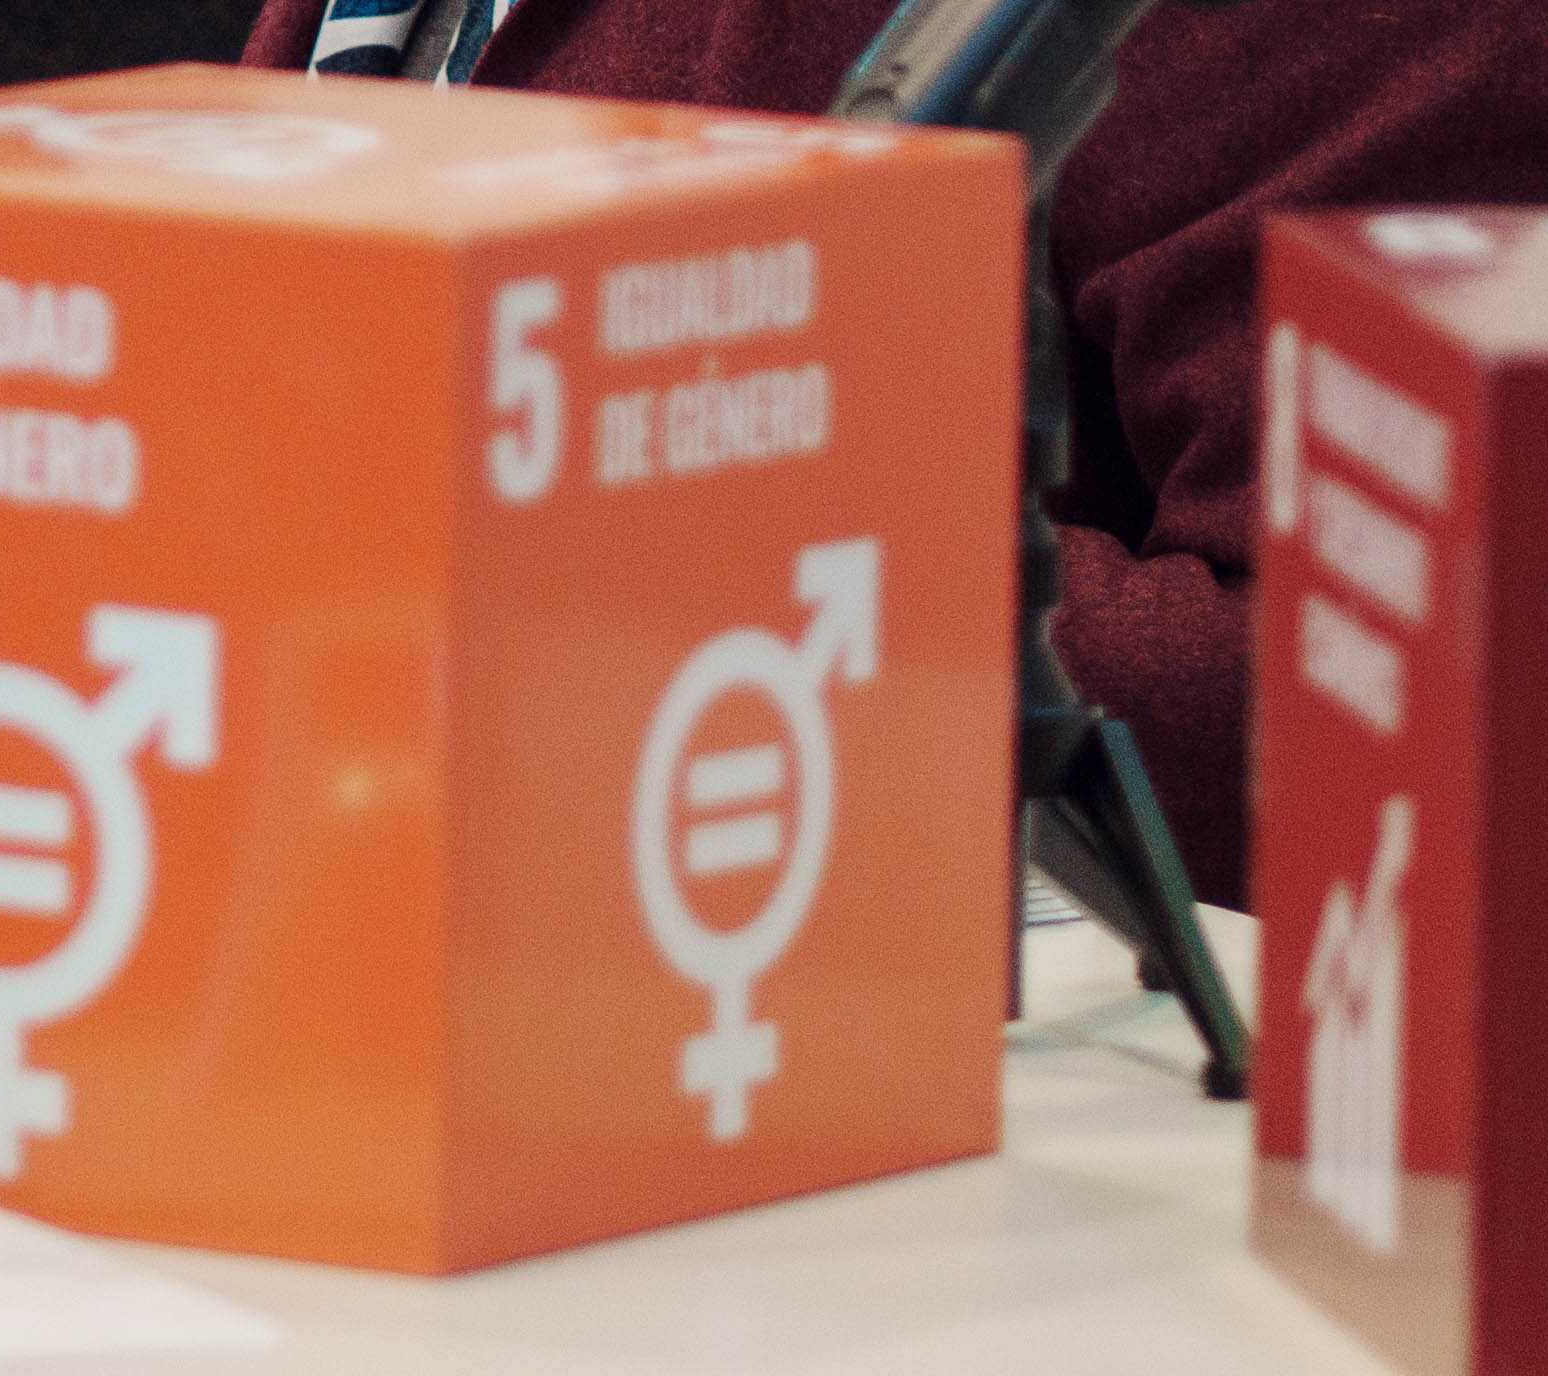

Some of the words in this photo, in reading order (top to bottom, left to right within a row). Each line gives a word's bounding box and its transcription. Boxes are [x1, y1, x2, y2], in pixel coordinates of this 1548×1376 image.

[596, 236, 816, 355] IGUALDAD
[486, 274, 562, 504] 5
[596, 388, 656, 488] DE
[662, 354, 834, 478] GÉNERO
